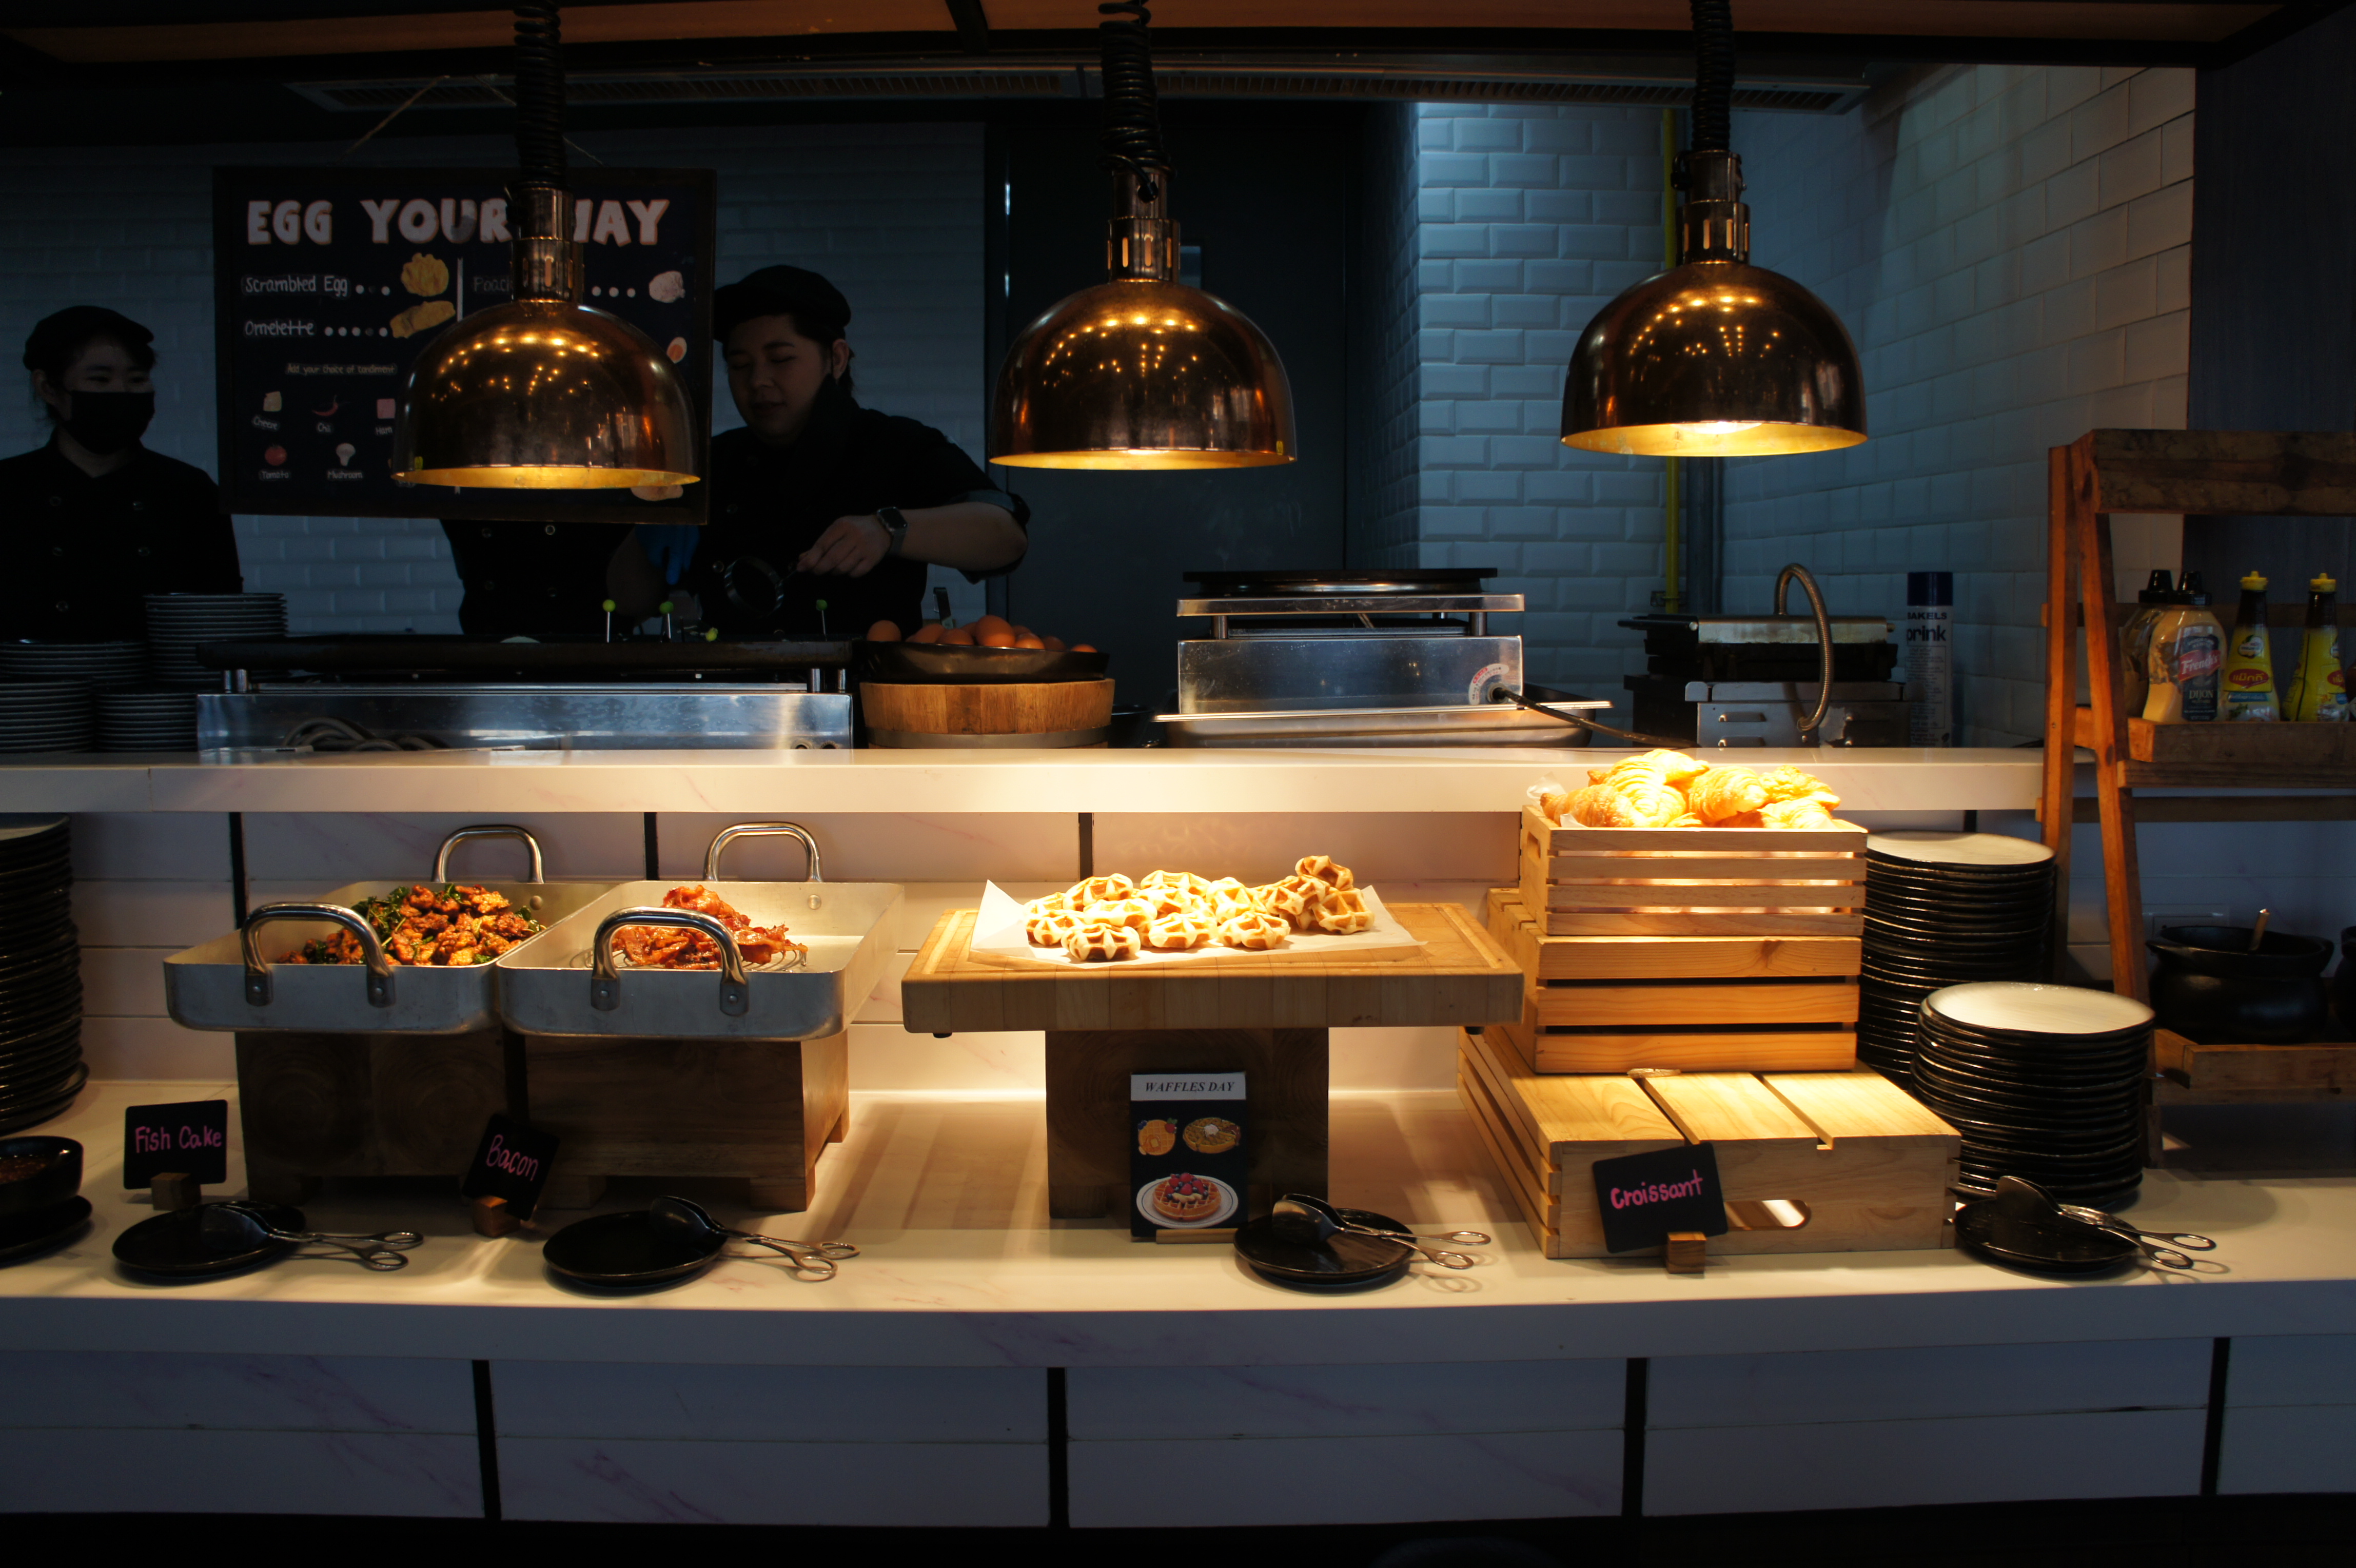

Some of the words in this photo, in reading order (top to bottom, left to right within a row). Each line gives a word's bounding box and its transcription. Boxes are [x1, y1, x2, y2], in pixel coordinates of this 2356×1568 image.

[247, 199, 333, 245] EGG
[359, 198, 513, 244] YOUR
[245, 275, 317, 293] Scrambled
[323, 277, 349, 297] Egg
[245, 320, 315, 337] Omelette
[303, 365, 321, 376] your
[346, 365, 355, 374] of
[376, 426, 393, 435] Ham
[262, 470, 289, 479] Tomato
[1145, 1082, 1205, 1092] WAFFLES
[1208, 1082, 1235, 1092] DAY
[134, 1126, 171, 1154] Fish
[179, 1124, 223, 1150] Cake
[485, 1133, 539, 1182] Bacon
[1609, 1168, 1703, 1209] Croissant
